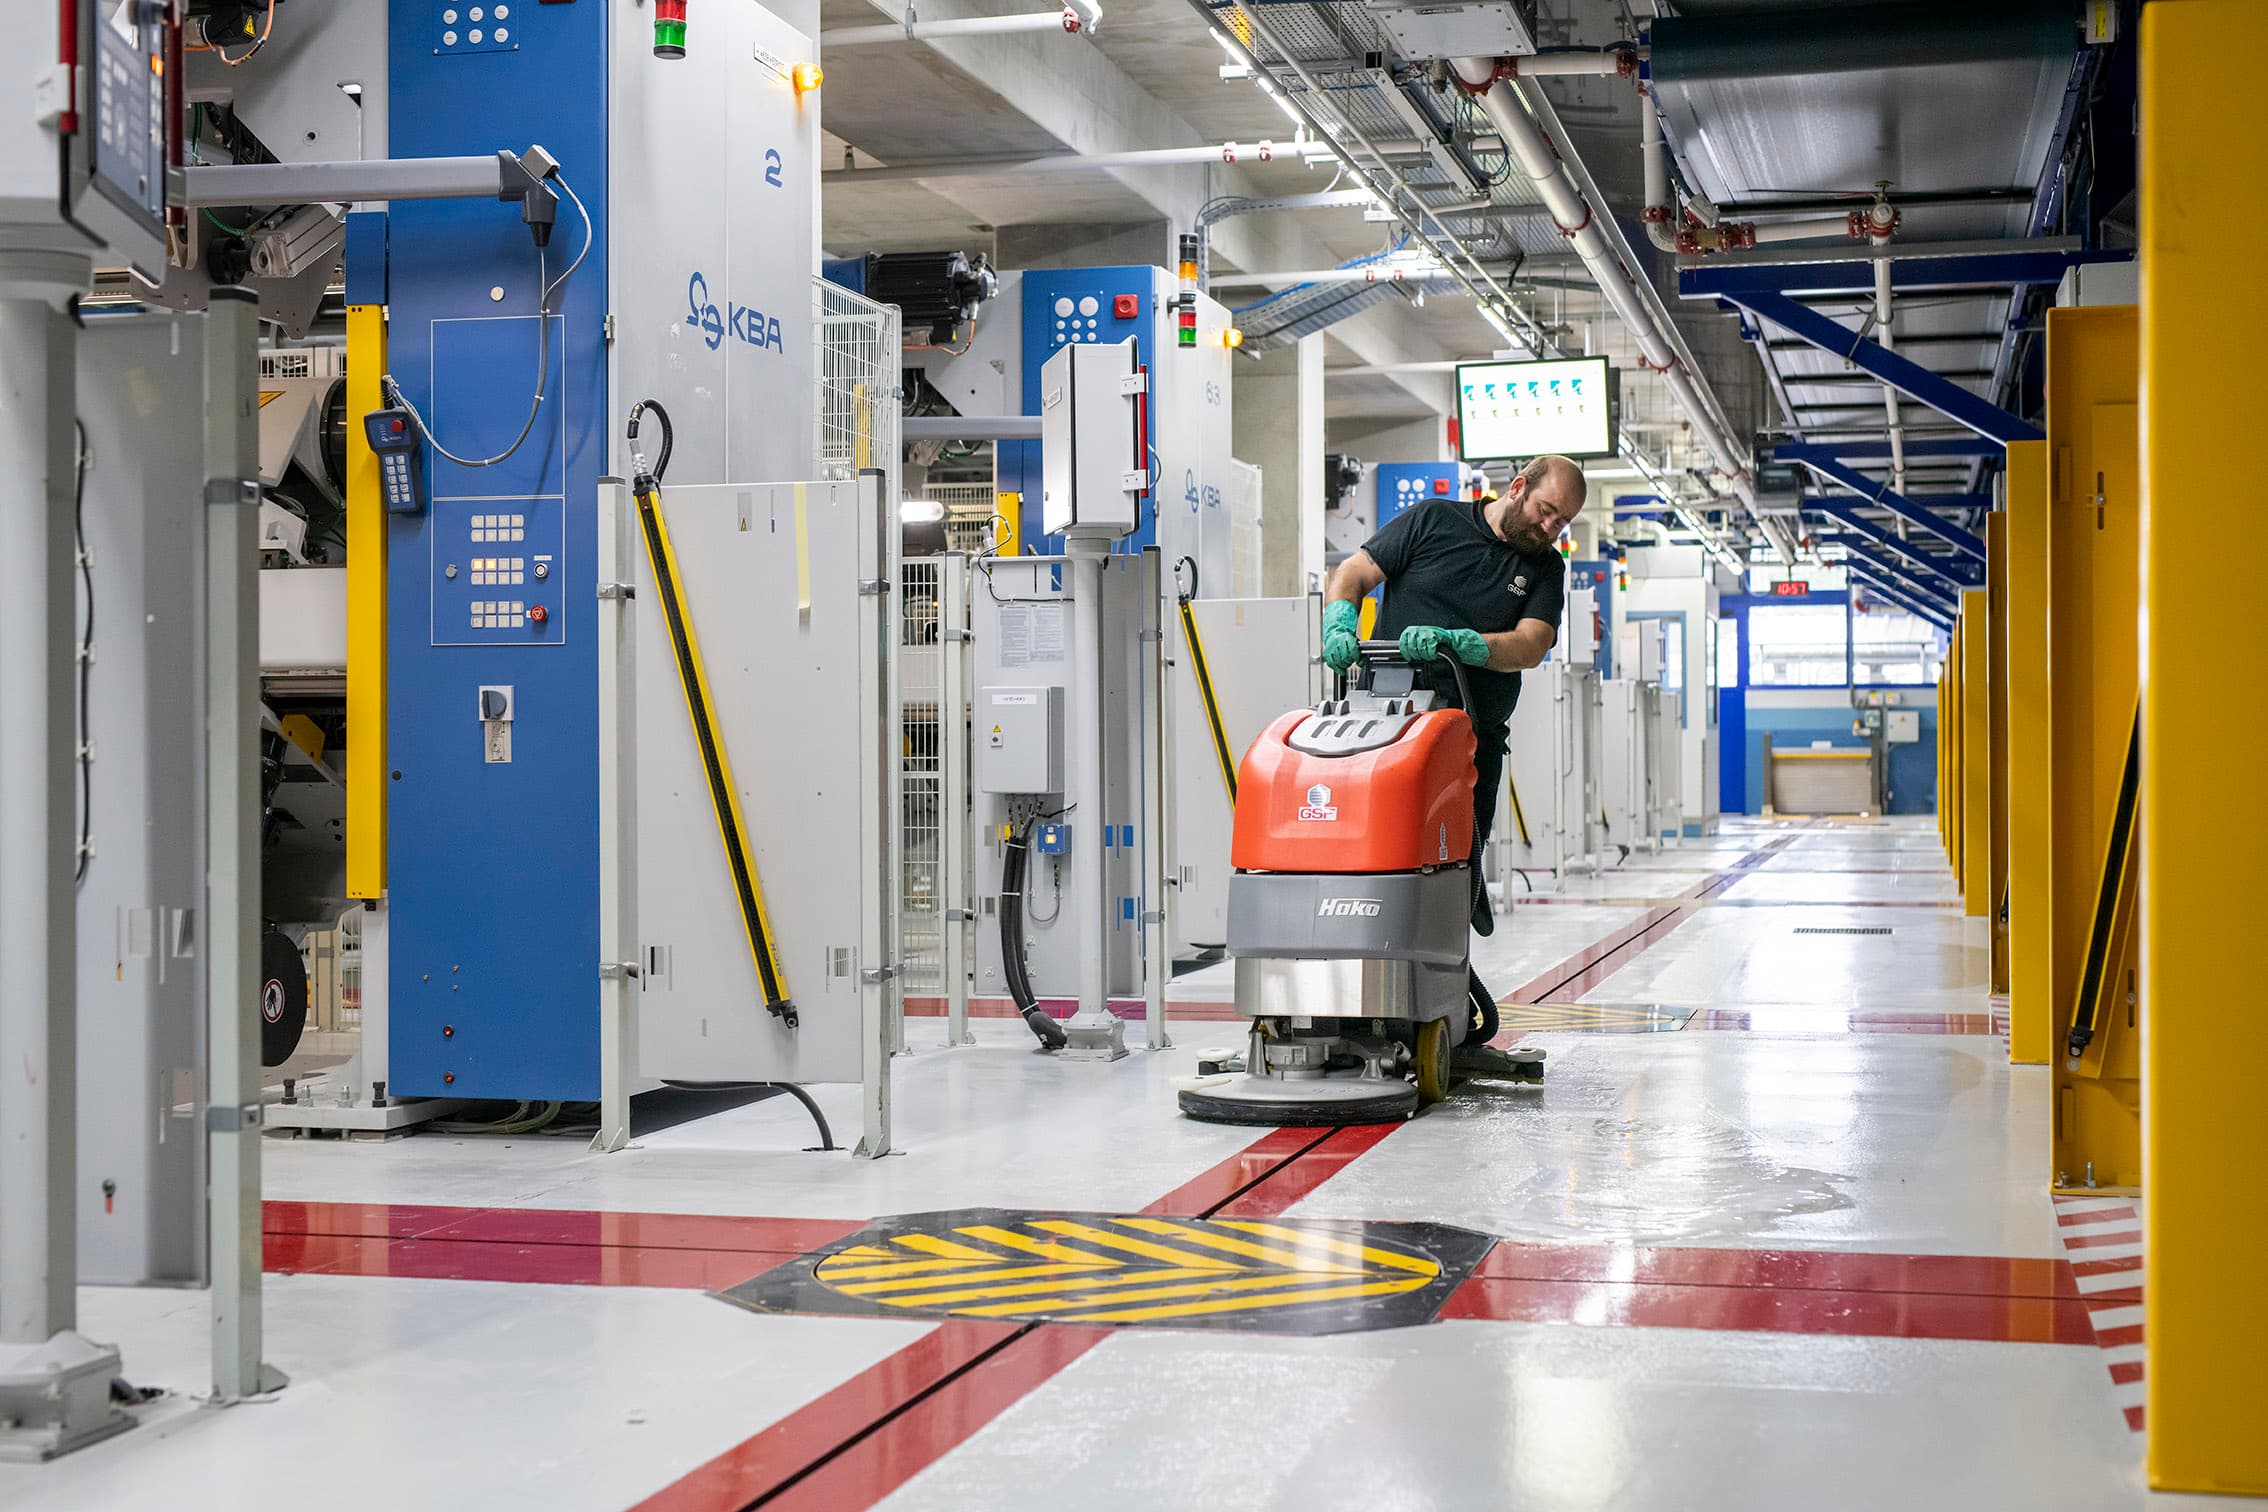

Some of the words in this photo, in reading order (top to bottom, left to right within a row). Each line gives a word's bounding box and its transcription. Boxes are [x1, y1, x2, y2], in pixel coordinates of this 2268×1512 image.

[765, 149, 782, 188] 2
[728, 301, 783, 354] KBA
[1200, 483, 1222, 511] KBA
[1300, 808, 1336, 819] GSF
[1318, 898, 1382, 917] Hako
